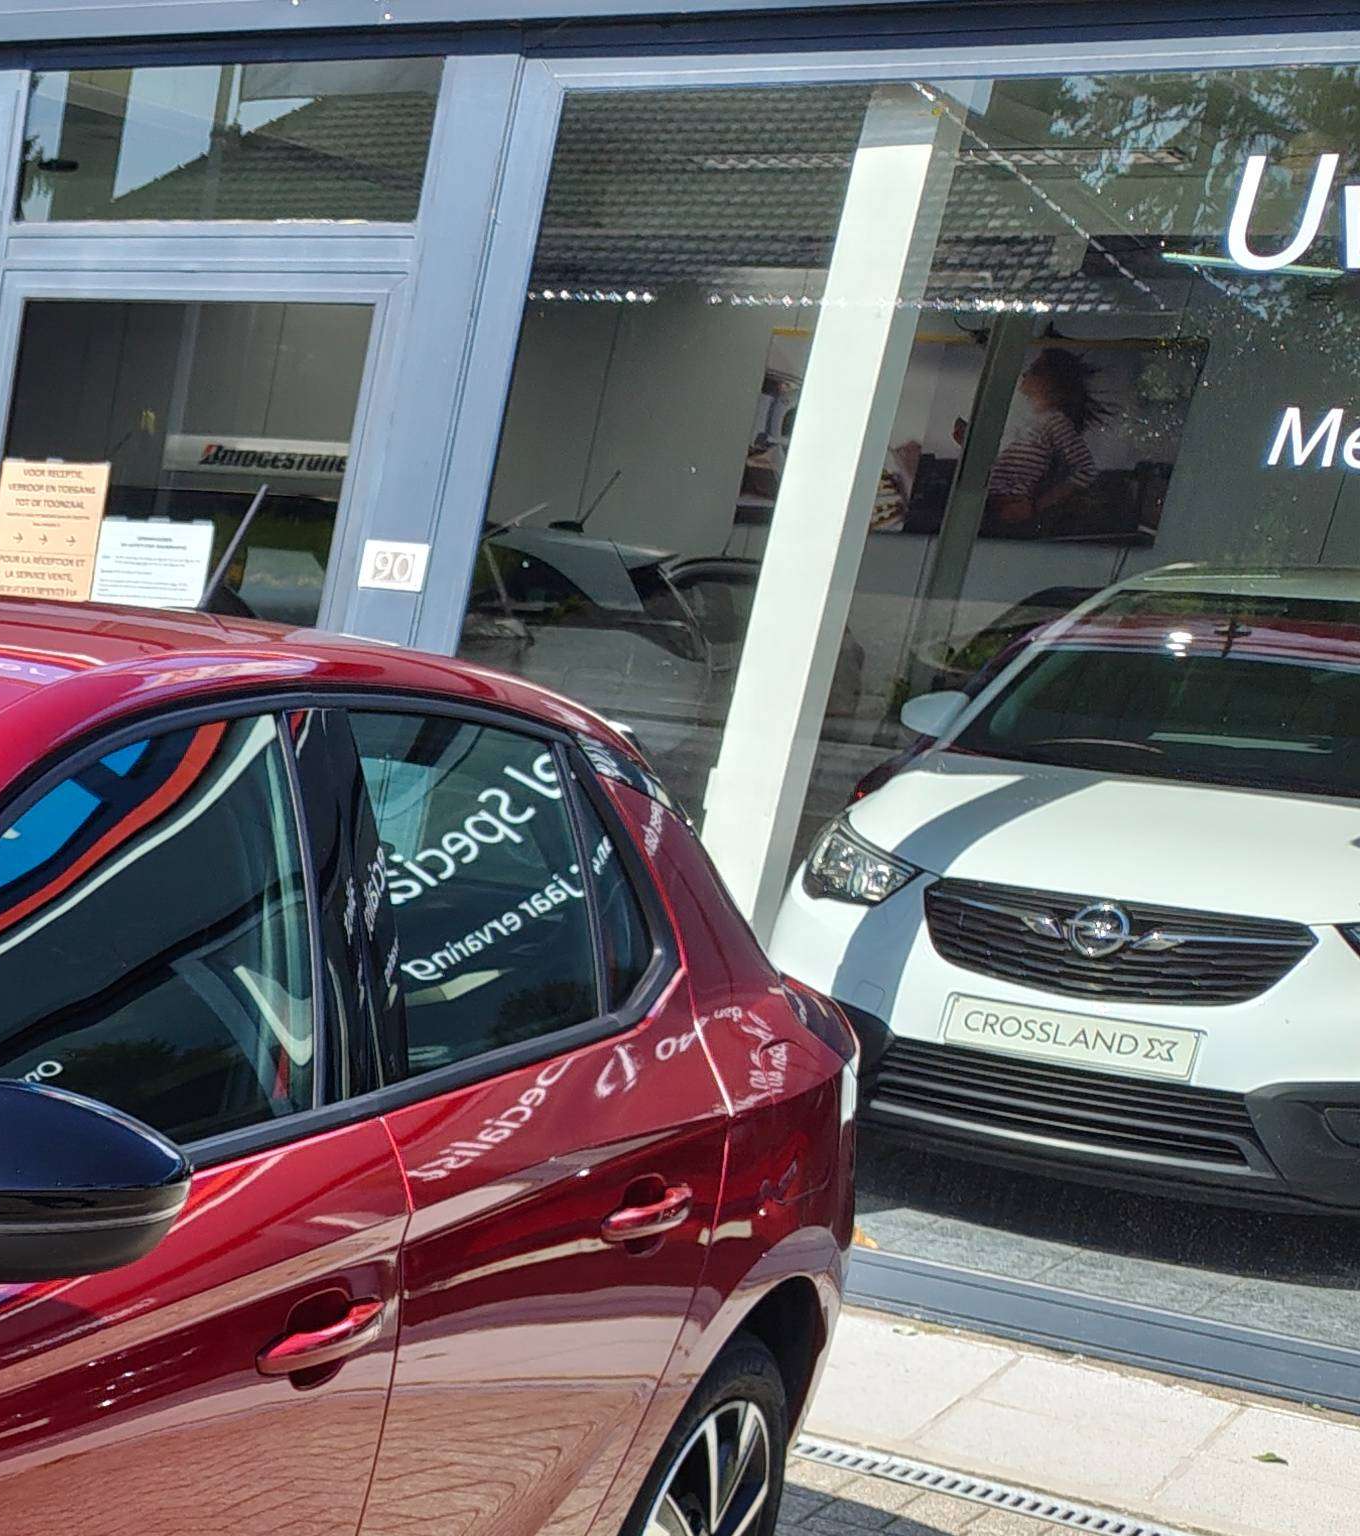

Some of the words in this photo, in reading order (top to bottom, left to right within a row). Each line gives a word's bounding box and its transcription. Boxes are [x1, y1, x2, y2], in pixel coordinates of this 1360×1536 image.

[1228, 153, 1360, 271] U
[372, 550, 415, 582] 90
[964, 1010, 1138, 1055] CROSSLAND
[1142, 1036, 1179, 1062] X
